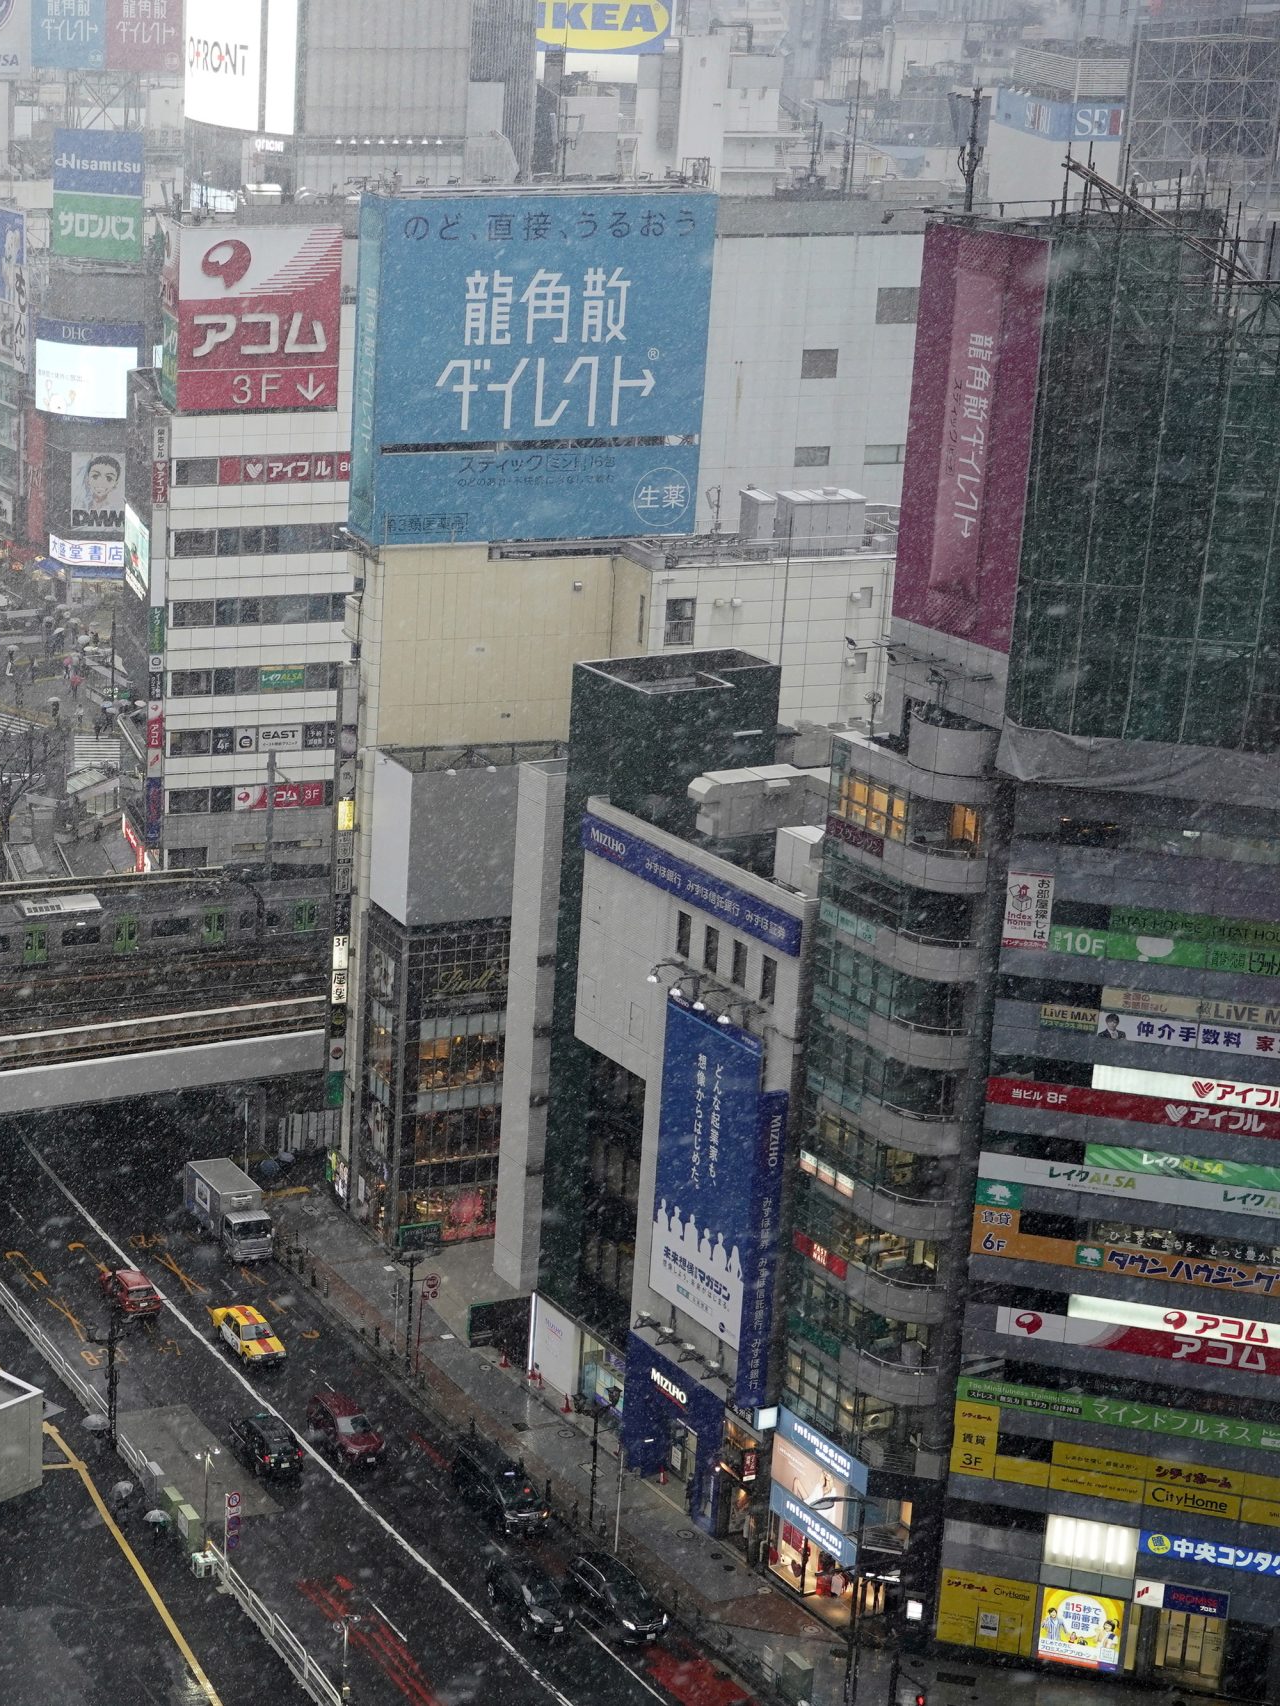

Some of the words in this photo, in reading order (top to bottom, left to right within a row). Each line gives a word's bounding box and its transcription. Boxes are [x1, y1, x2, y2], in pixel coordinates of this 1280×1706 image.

[534, 2, 659, 32] IKEA
[41, 19, 99, 42] ダイレクト
[116, 20, 176, 45] ダイレクト
[188, 37, 249, 77] QFRONT
[1074, 107, 1124, 137] SEI
[59, 212, 136, 242] サロンパス
[404, 210, 696, 241] のど、直接、うるおう
[464, 266, 631, 346] 龍角散
[61, 325, 93, 340] DHC
[193, 311, 328, 357] アコム
[232, 374, 282, 404] 3F
[435, 355, 656, 431] ダイレクト
[269, 460, 331, 478] アイフル
[156, 471, 166, 502] アイフル
[637, 484, 686, 509] 生薬
[51, 539, 124, 562] 大盛堂書店
[261, 729, 299, 740] EAST
[265, 791, 298, 802] コム
[304, 789, 320, 800] 3F
[590, 827, 626, 855] MIZUHO
[645, 858, 682, 886] みずほ銀行
[686, 880, 740, 917] みずほ信託銀行
[745, 910, 786, 940] みずほ証券
[1033, 879, 1051, 939] お部屋探しは
[335, 937, 348, 947] 3F
[1063, 931, 1105, 955] 10F
[1211, 926, 1248, 938] PITAT
[1070, 1011, 1097, 1023] MAX
[1137, 1021, 1242, 1048] 仲介手数料
[1012, 1088, 1042, 1100] 当ビル
[1046, 1092, 1067, 1104] 8F
[1189, 1106, 1265, 1132] アイフル
[768, 1114, 782, 1167] MIZUHO
[1142, 1154, 1224, 1175] レイクALSA
[1049, 1166, 1136, 1189] レイクALSA
[1222, 1190, 1280, 1210] レイクA
[982, 1211, 1012, 1226] 賃貸
[813, 1243, 827, 1259] FAST
[981, 1232, 1007, 1251] 6F
[1196, 1315, 1269, 1344] アコム
[1173, 1336, 1267, 1371] アコム
[651, 1368, 688, 1405] MIZUHO
[1092, 1403, 1252, 1442] マインドフルネス
[793, 1422, 851, 1471] intimissimi
[961, 1432, 987, 1447] 賃貸
[962, 1453, 982, 1467] 3F
[1154, 1464, 1232, 1490] シティホーム
[1151, 1487, 1228, 1512] CityHome
[785, 1500, 842, 1549] intimissimi
[947, 1579, 988, 1593] シティホーム
[993, 1587, 1030, 1601] CityHome
[1171, 1592, 1218, 1608] PROMISE
[1200, 1605, 1218, 1614] プロミス
[1071, 1621, 1090, 1632] 回答
